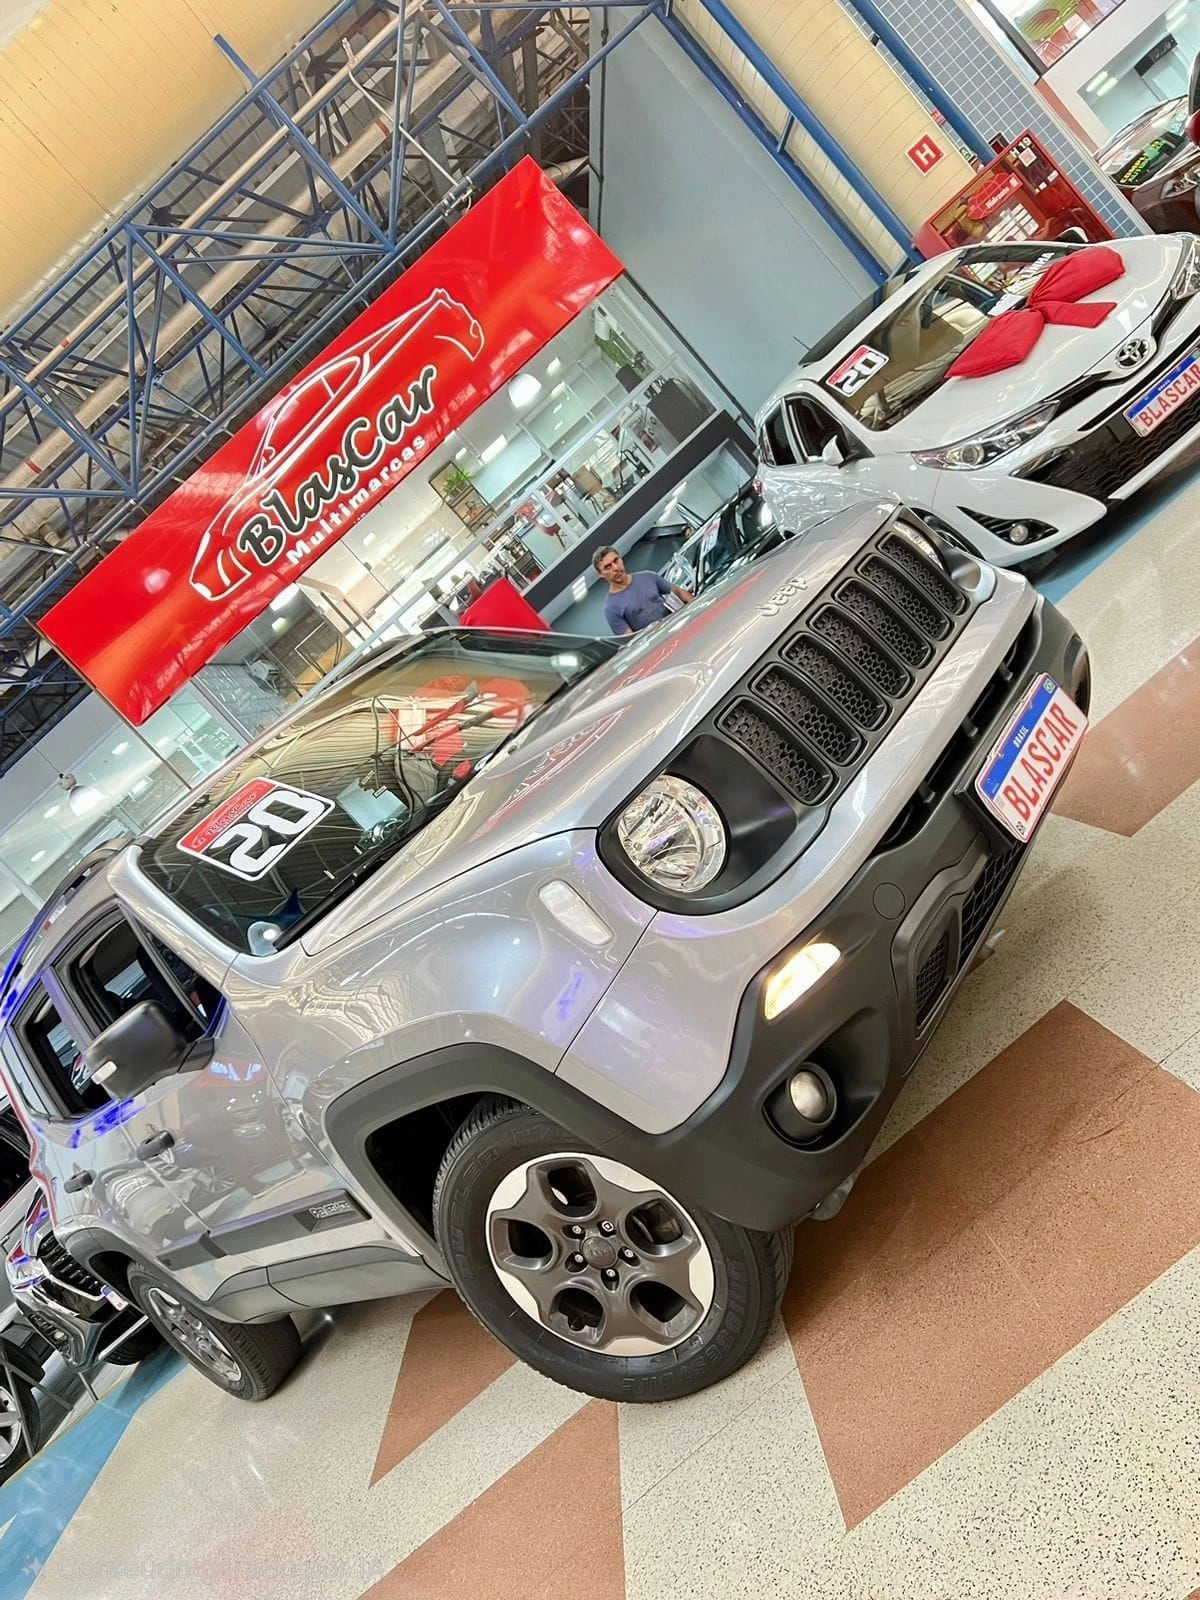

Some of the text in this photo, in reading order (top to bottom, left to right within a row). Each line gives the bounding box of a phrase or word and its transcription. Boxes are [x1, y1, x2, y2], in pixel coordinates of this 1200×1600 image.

[915, 143, 936, 166] H
[1010, 137, 1032, 158] H 19
[837, 351, 886, 393] 20
[236, 364, 438, 566] BlasCar
[285, 434, 427, 566] Multimarcas
[755, 576, 808, 617] Jeep
[1012, 725, 1030, 749] BRASIL
[1002, 702, 1078, 822] BLASCAR
[209, 789, 327, 873] 20
